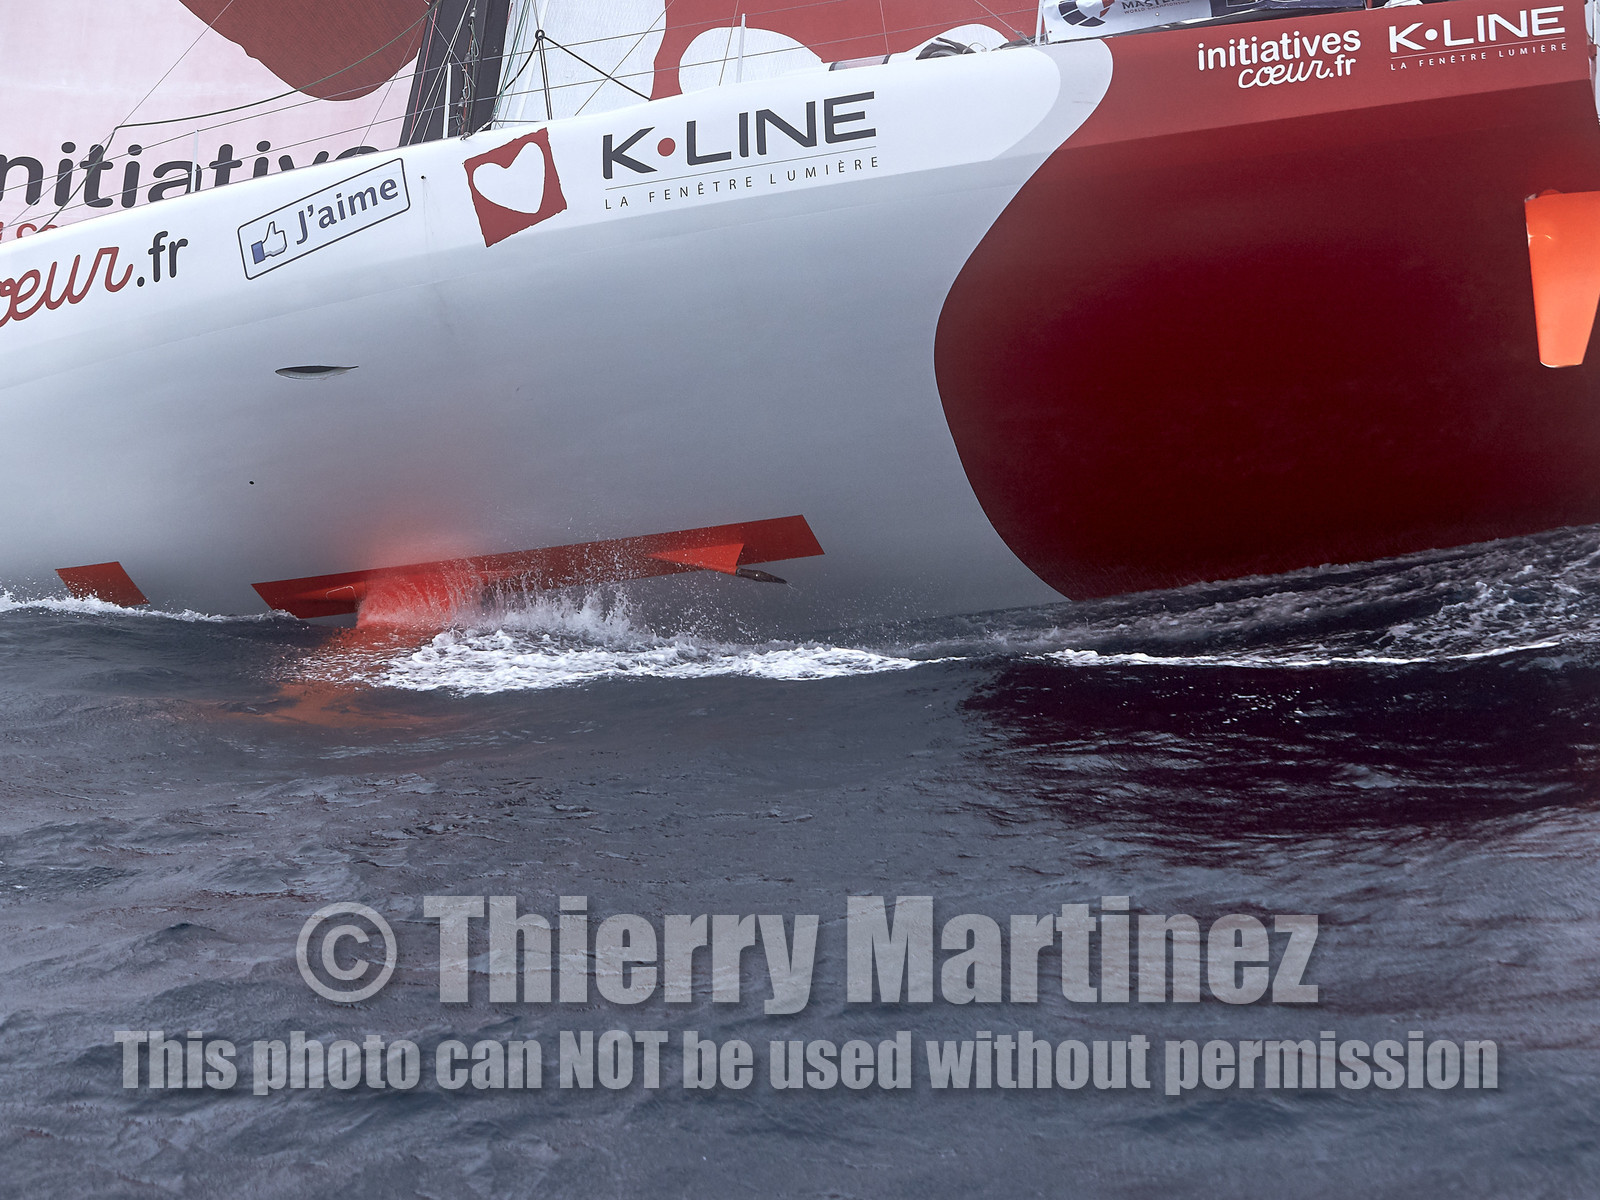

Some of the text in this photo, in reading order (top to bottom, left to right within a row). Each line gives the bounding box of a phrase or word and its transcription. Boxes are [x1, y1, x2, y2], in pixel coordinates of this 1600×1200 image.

[1196, 29, 1362, 72] initiatives
[1390, 42, 1568, 71] LA FENÊTRE LUMIÈRE
[604, 156, 880, 211] LA FENÊTRE LUMIÈRE
